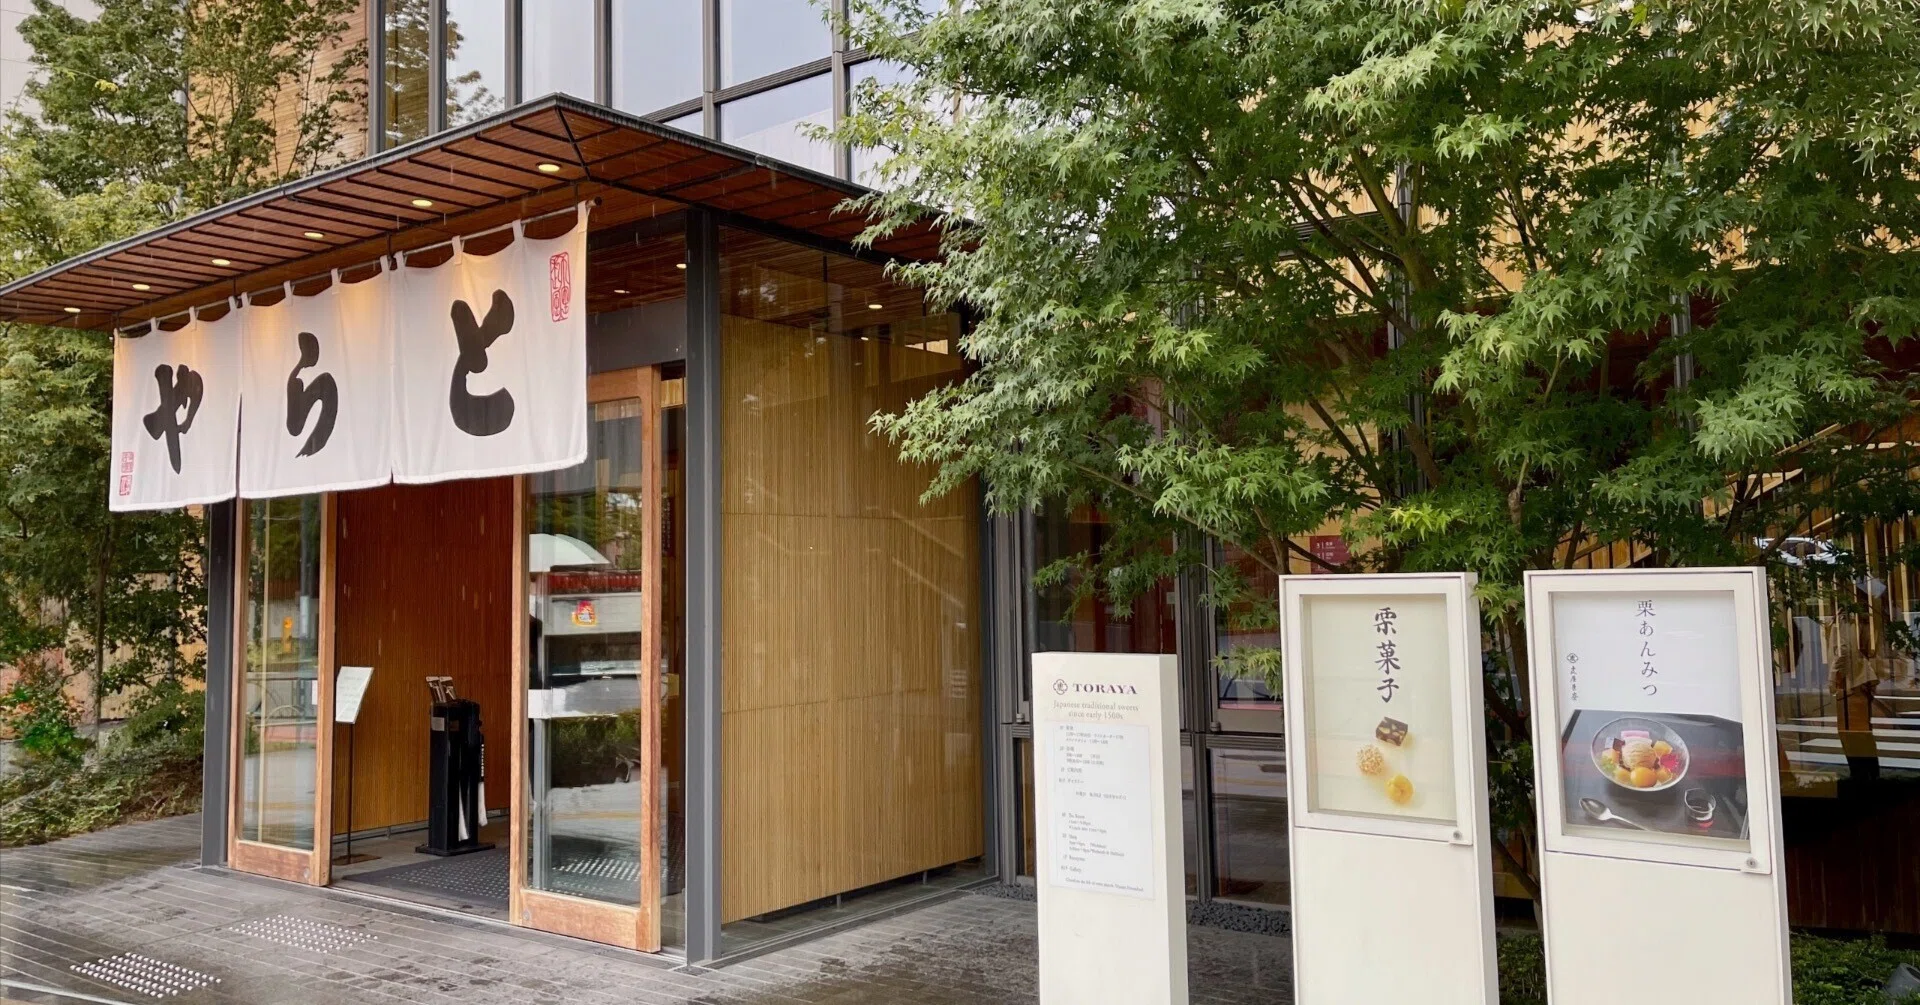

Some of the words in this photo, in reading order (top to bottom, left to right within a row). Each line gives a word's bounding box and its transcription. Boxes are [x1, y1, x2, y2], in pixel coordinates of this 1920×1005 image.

[1634, 599, 1658, 697] 栗あんみつ
[1373, 607, 1401, 703] 栗菓子
[1072, 683, 1138, 695] TORAYA
[1053, 700, 1080, 709] Japanese
[1082, 701, 1116, 710] traditional
[1086, 711, 1102, 720] early
[1104, 711, 1123, 720] 1500s
